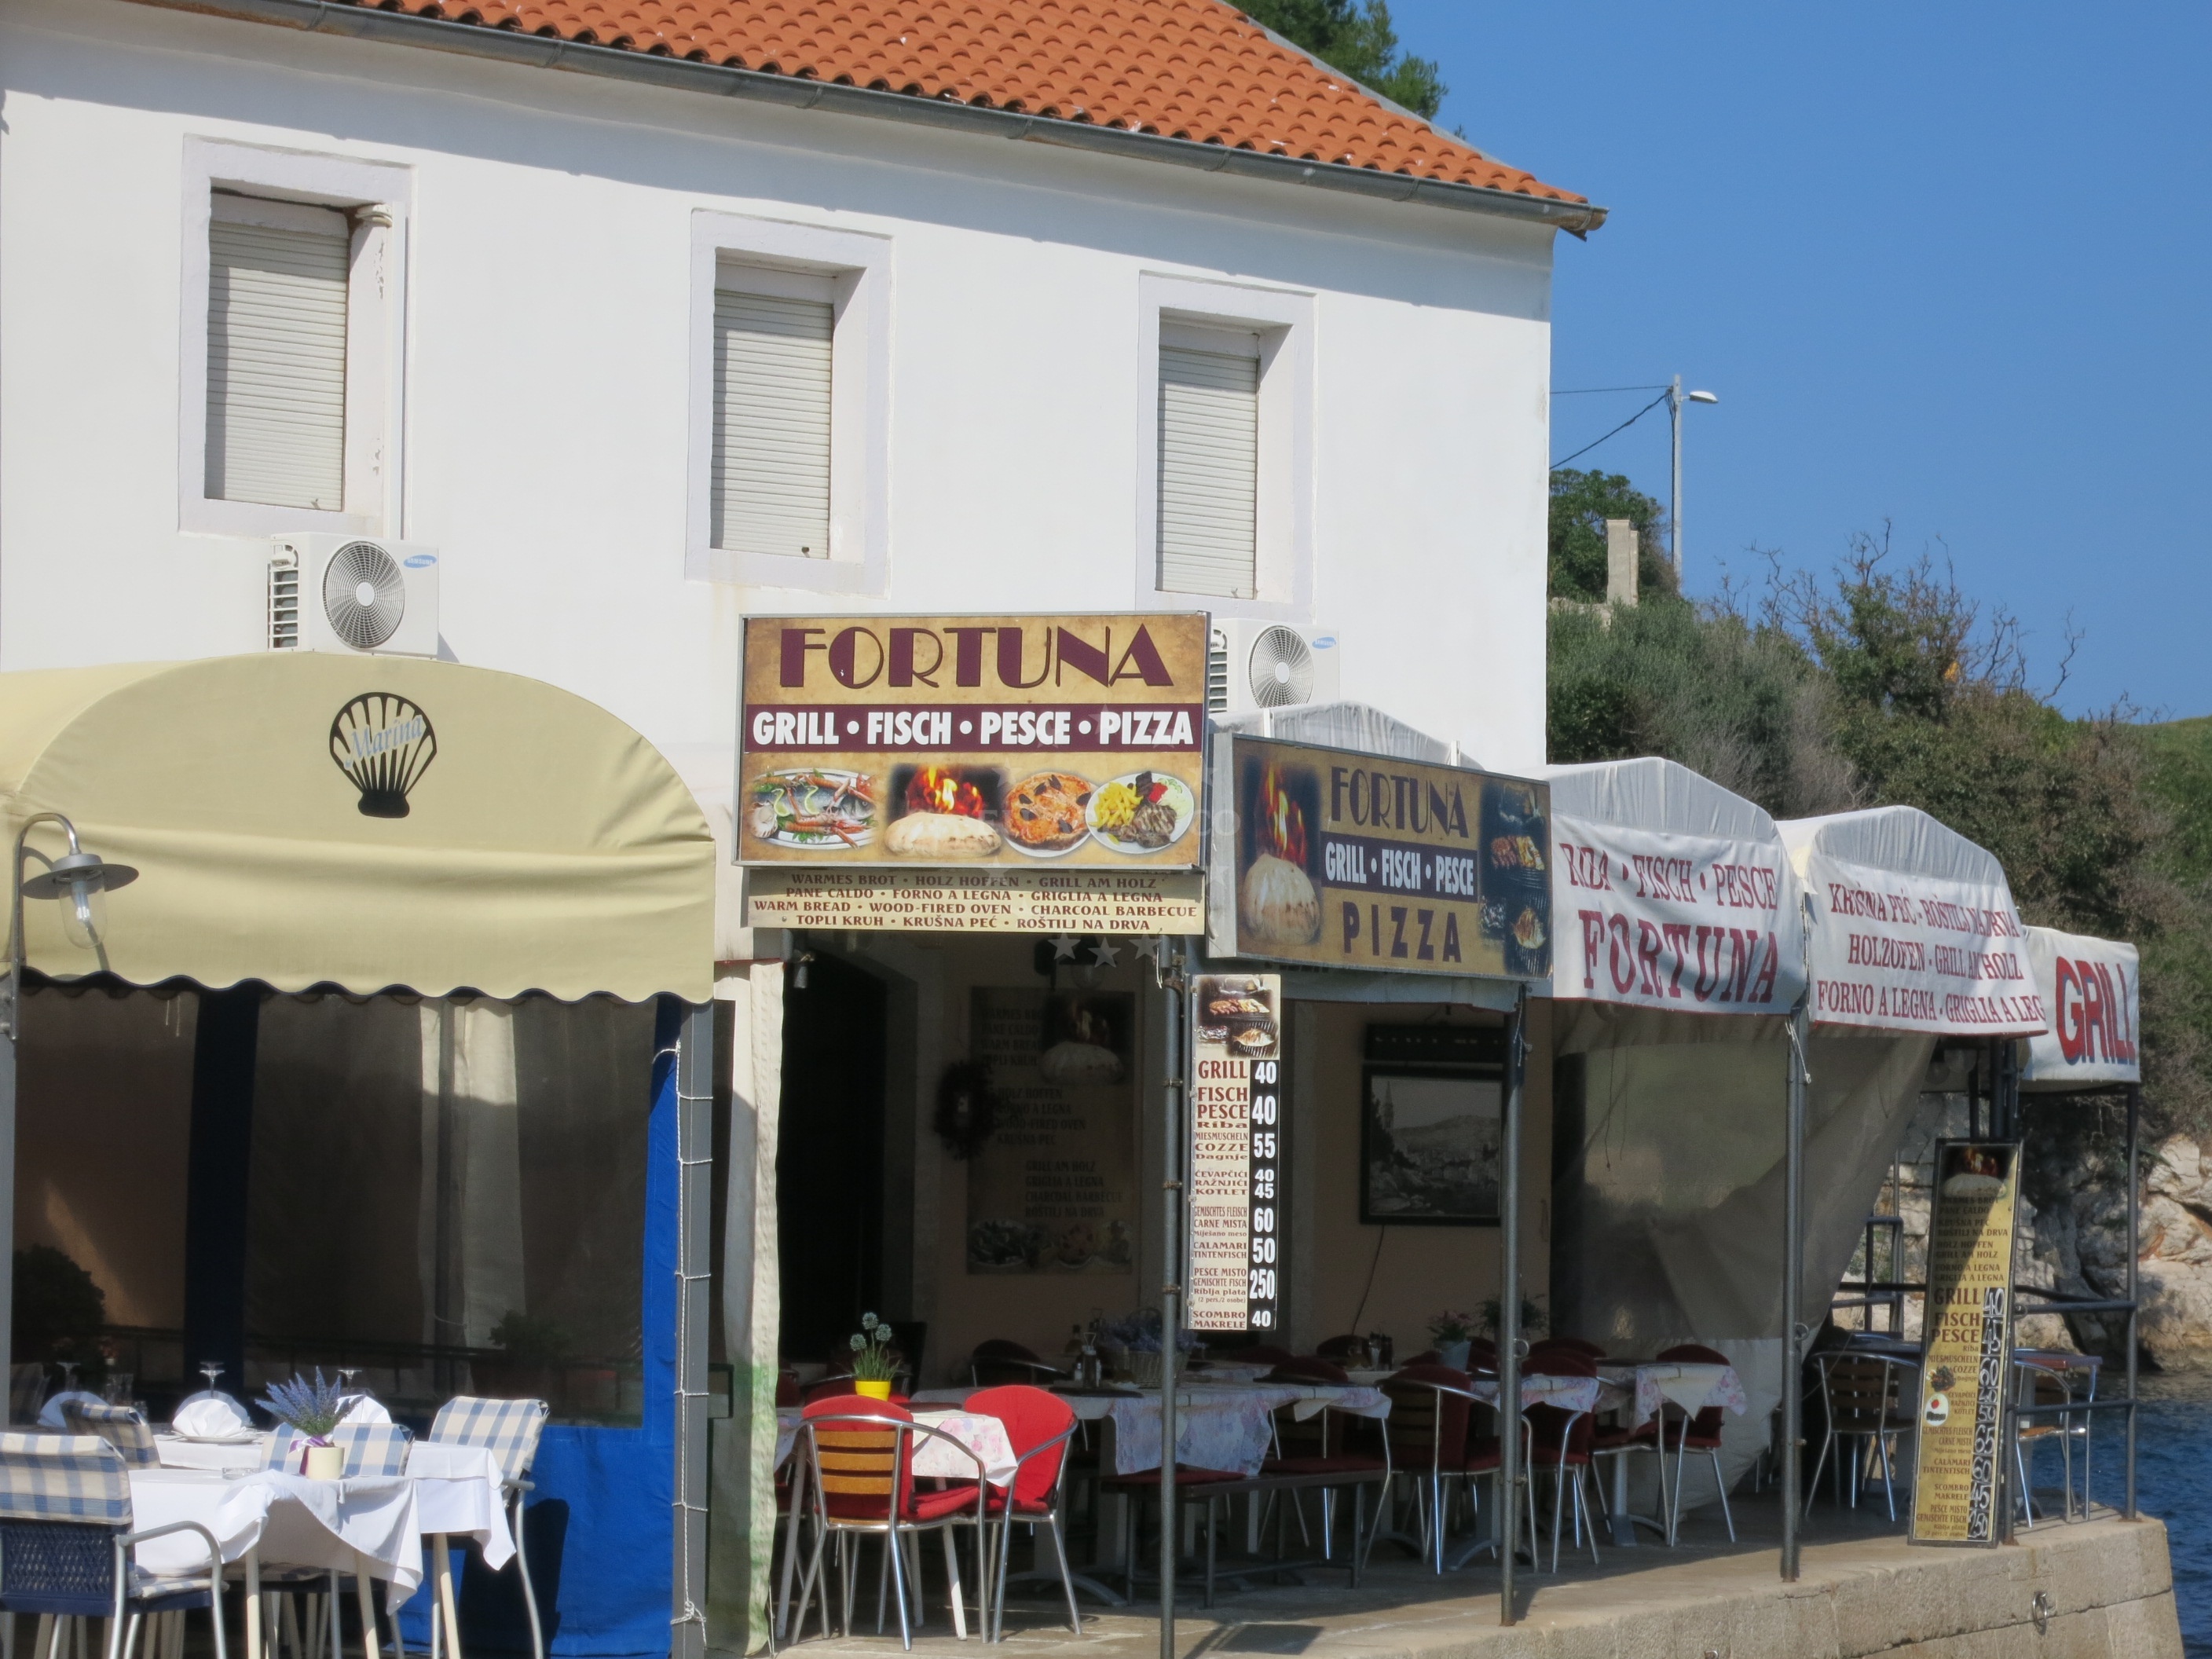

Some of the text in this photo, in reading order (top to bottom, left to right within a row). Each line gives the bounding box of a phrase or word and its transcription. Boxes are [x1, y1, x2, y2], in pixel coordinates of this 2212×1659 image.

[779, 624, 1174, 689] FORTUNA
[753, 711, 1193, 745] GRILL FISCH PESCE PIZZA
[344, 716, 423, 769] Marina
[1331, 765, 1469, 839] FORTUNA
[792, 874, 1156, 888] WARMES BROT HOLZ HOFFEN GRILL AM HOLZ
[1325, 841, 1474, 895] GRILL FISCH PESCE
[786, 888, 1163, 903] PANE CALDO FORNO A LEGNA GRIGLIA A LEGNA
[1632, 855, 1697, 903] FISCH
[1712, 863, 1778, 910] PESCE
[754, 901, 1196, 917] WARM BREAD WOOD-FIRED OVEN CHARCOAL BARBECUE
[797, 914, 1150, 930] TOPLI KRUH KRUŠNA PEĆ ROŠTILJ NA DRVA
[1342, 901, 1462, 963] PIZZA
[1578, 910, 1778, 1004] FORTUNA
[1848, 934, 2024, 980] HOLZOFEN GRILL AM HOLZ
[1817, 980, 1874, 1015] FORNO
[1878, 987, 1888, 1016] A
[1892, 987, 1937, 1020] LEGNA
[1946, 993, 2003, 1024] GRIGLIA
[2000, 997, 2017, 1022] A
[2056, 955, 2137, 1066] GRILL
[1198, 1060, 1276, 1084] GRILL 40
[1198, 1086, 1247, 1102] FISCH
[1197, 1096, 1276, 1126] PESCE 40
[1196, 1132, 1248, 1141] MIESMUSCHELN
[1196, 1133, 1275, 1159] COZZE 55
[1254, 1170, 1274, 1181] 40
[1254, 1183, 1274, 1199] 45
[1194, 1207, 1247, 1217] GEMISCHTES FLEISCH
[1254, 1207, 1274, 1232] 60
[1253, 1238, 1276, 1263] 50
[1221, 1268, 1247, 1276] MISTO
[1250, 1269, 1275, 1299] 250
[1934, 1286, 2005, 1316] GRILL 40
[1251, 1310, 1271, 1328] 40
[1935, 1313, 1980, 1327] FISCH
[1932, 1318, 2003, 1354] PESCE 45
[1979, 1357, 1999, 1386] 60
[1975, 1424, 1996, 1453] 65
[1923, 1456, 1992, 1481] TINTENFISCH 60
[1969, 1482, 1992, 1509] 45
[1931, 1504, 1968, 1514] PESCE MISTO
